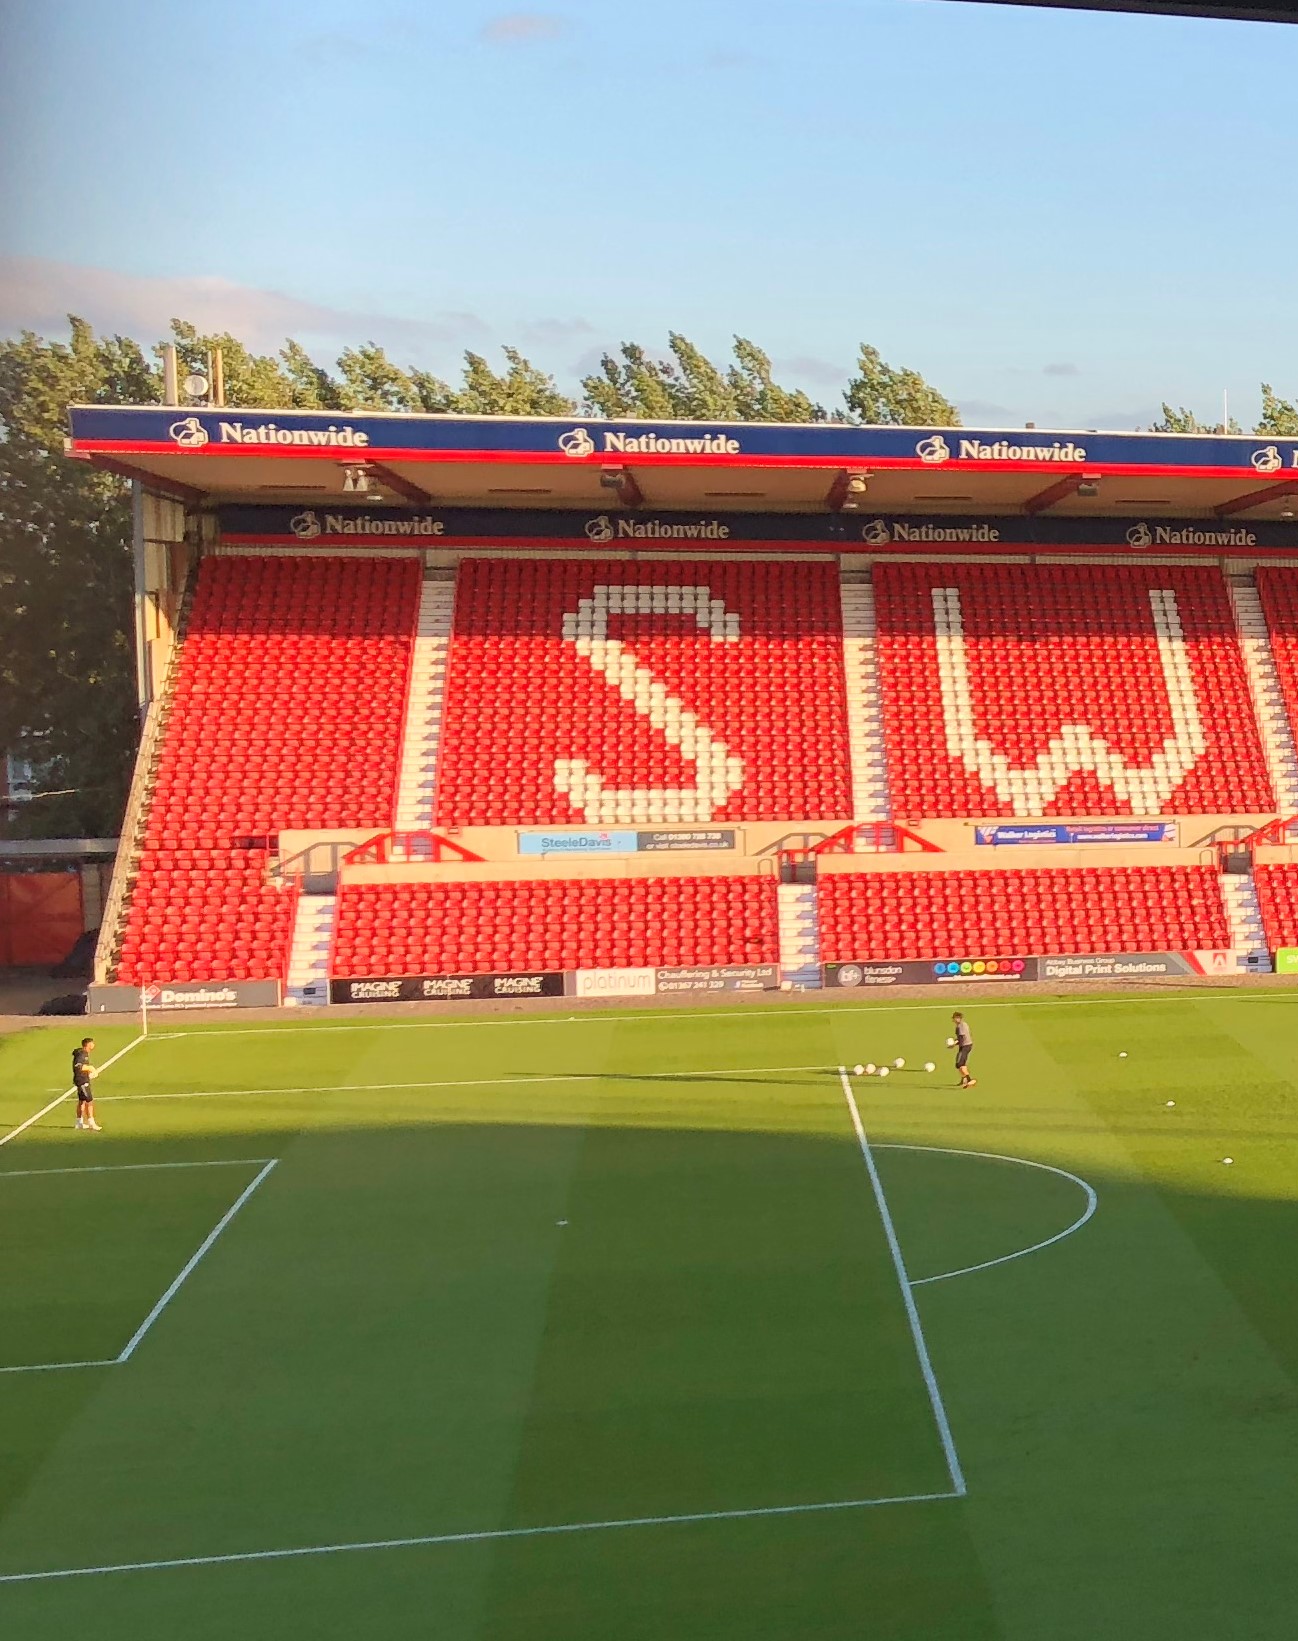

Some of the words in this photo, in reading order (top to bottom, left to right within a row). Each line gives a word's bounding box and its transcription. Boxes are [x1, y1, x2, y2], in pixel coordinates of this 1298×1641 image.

[220, 422, 369, 448] Nationwide
[603, 431, 740, 456] Nationwide
[959, 439, 1086, 463] Nationwide
[325, 514, 444, 538] Nationwide
[617, 518, 730, 541] Nationwide
[892, 522, 999, 543] Nationwide
[1155, 526, 1257, 547] Nationwide
[541, 836, 612, 847] SteeleDavis
[720, 968, 756, 979] Security
[757, 967, 772, 976] Ltd
[1046, 965, 1082, 977] Digital
[1085, 964, 1112, 974] Print
[1114, 962, 1167, 973] Solutions
[351, 981, 402, 992] IMAGINE
[423, 979, 473, 989] IMAGINE
[494, 977, 543, 988] IMAGINE
[494, 985, 541, 994] CRUISING
[583, 971, 650, 995] platinum
[161, 988, 237, 1003] Domino's
[351, 990, 400, 999] CRUISING
[424, 987, 471, 996] CRUISING
